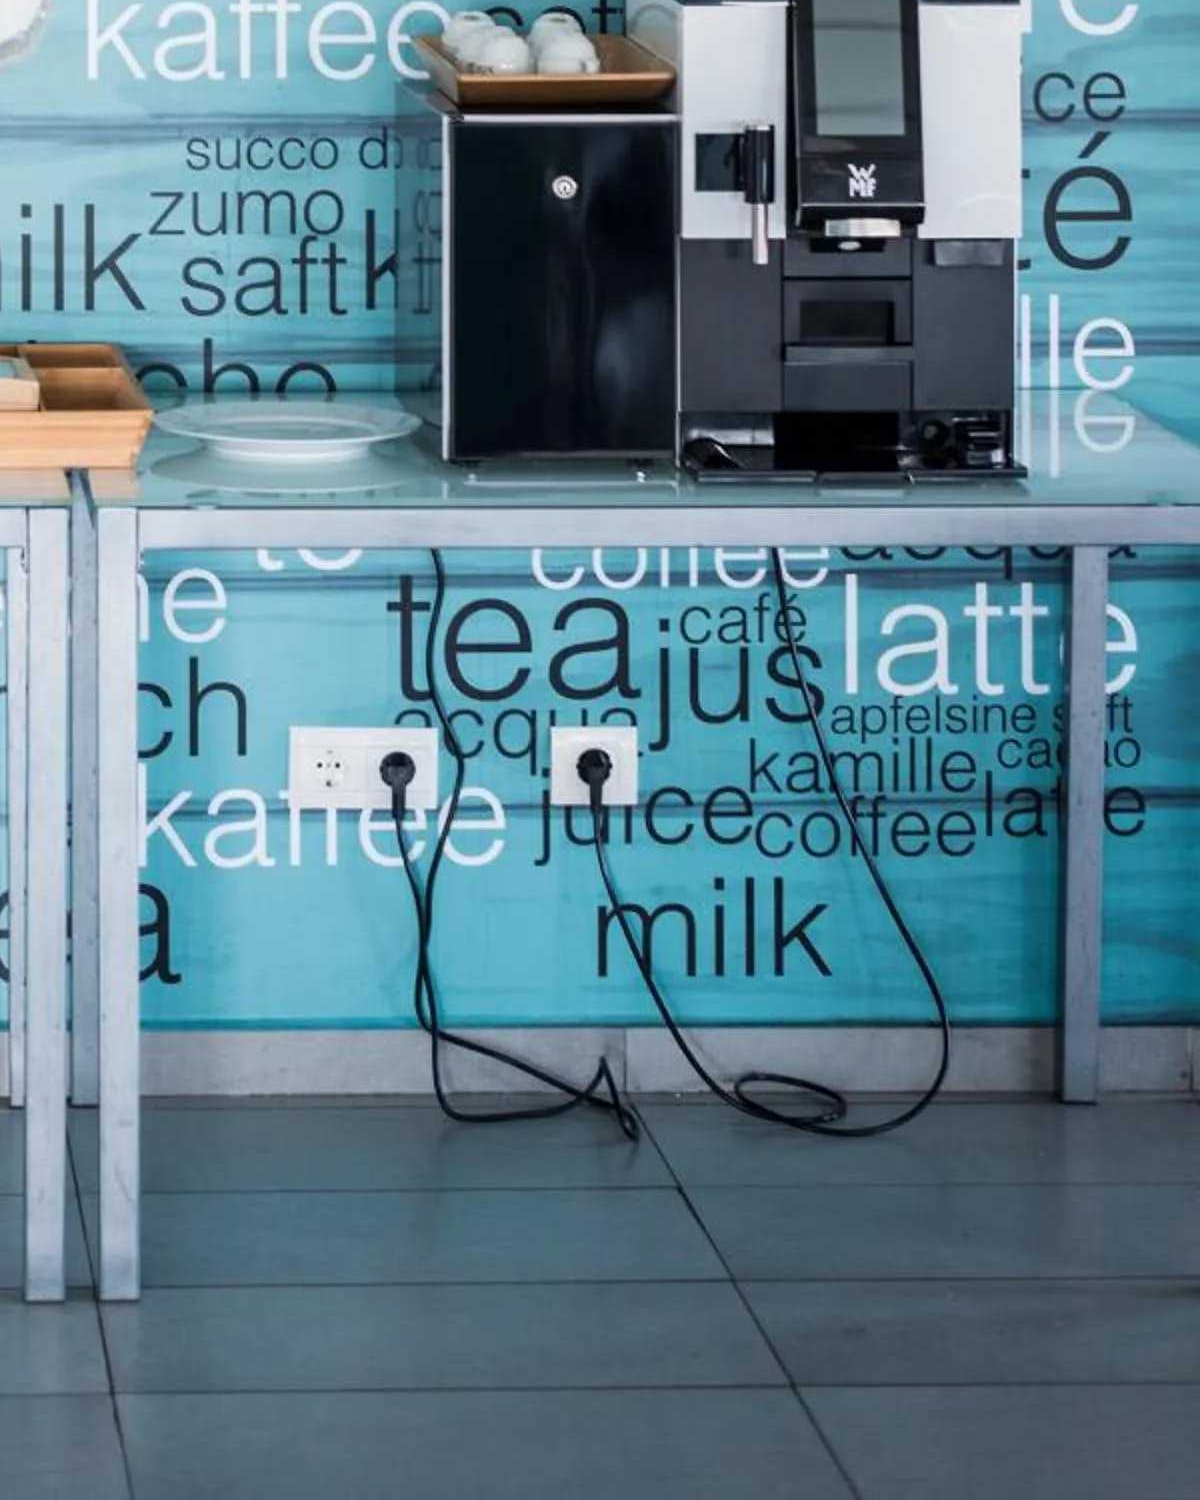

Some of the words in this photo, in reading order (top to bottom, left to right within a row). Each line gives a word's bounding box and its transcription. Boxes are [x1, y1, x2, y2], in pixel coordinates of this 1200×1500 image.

[185, 134, 340, 171] succo
[148, 188, 345, 237] zumo
[179, 234, 349, 317] saft
[385, 574, 642, 702] tea
[678, 594, 808, 645] café
[649, 618, 825, 751] jus
[830, 695, 1038, 745] apfelsine
[748, 736, 978, 794] kamille
[755, 795, 978, 859] coffee
[597, 877, 834, 977] milk
